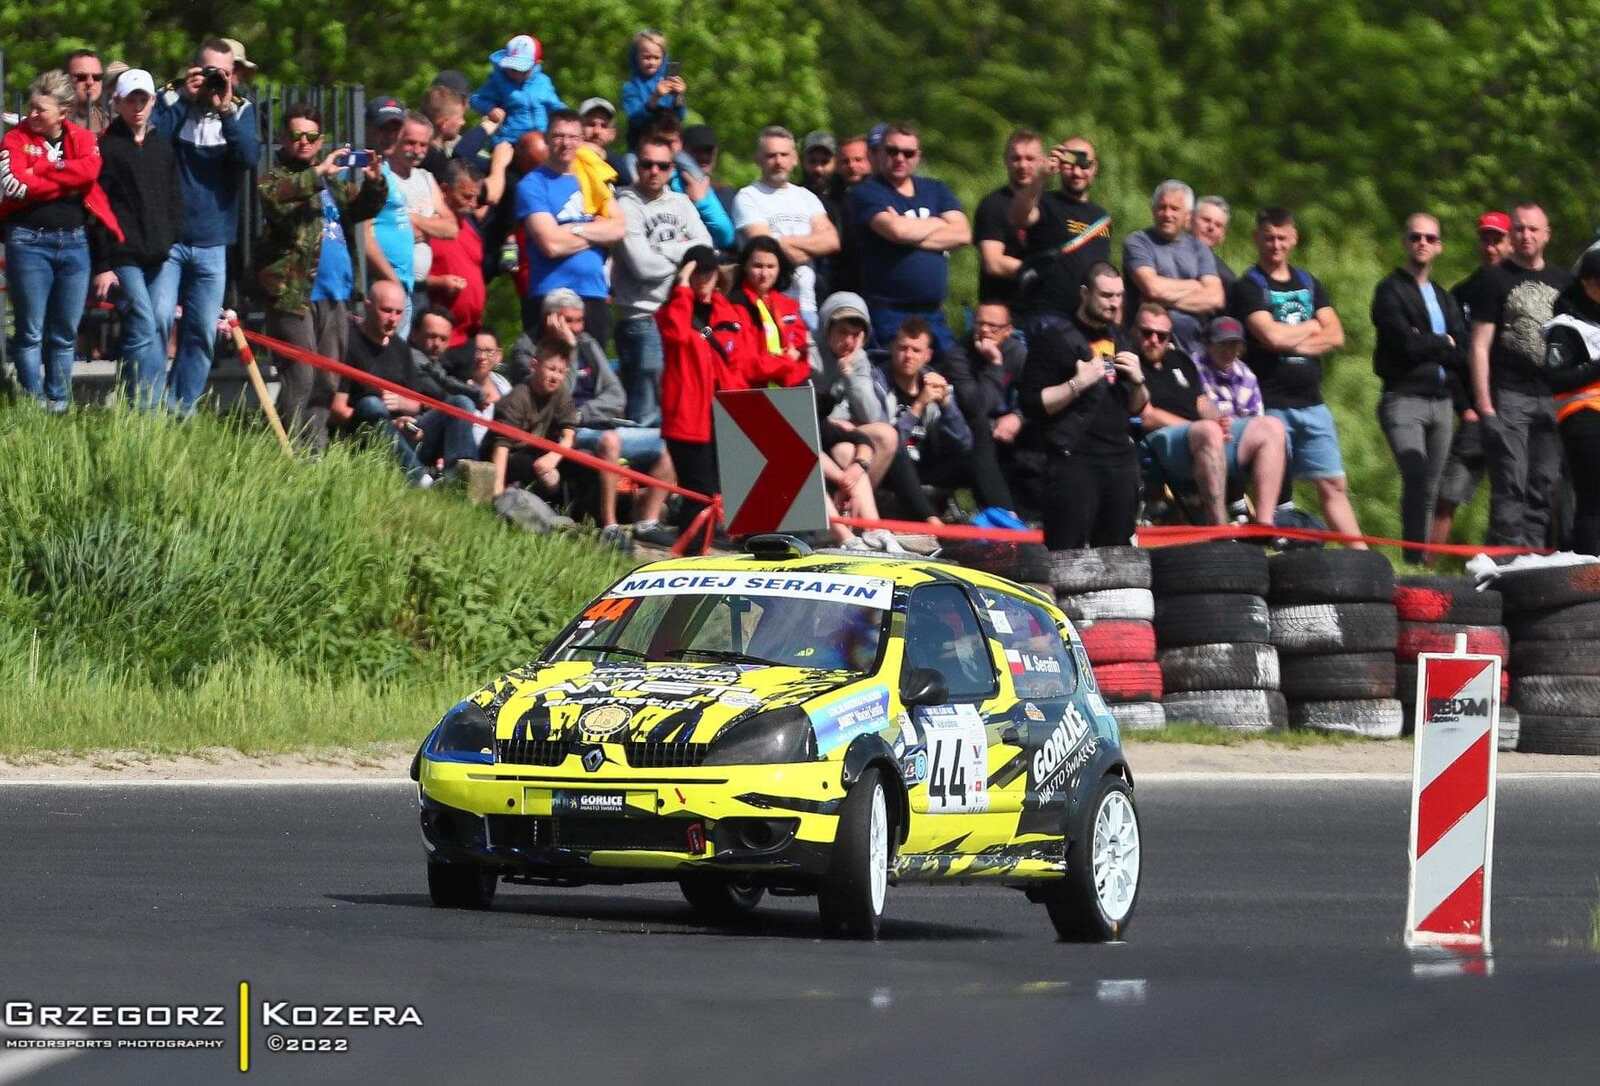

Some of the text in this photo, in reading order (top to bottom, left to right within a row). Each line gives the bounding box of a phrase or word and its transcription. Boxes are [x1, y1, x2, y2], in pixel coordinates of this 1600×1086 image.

[623, 576, 737, 592] MACIEJ
[744, 577, 878, 600] SERAFIN
[582, 598, 635, 621] 44
[1023, 654, 1061, 674] M. Serafin
[1033, 701, 1090, 785] GORLICE
[929, 739, 967, 807] 44
[580, 795, 623, 806] GORLICE
[1038, 770, 1065, 809] MIASTO
